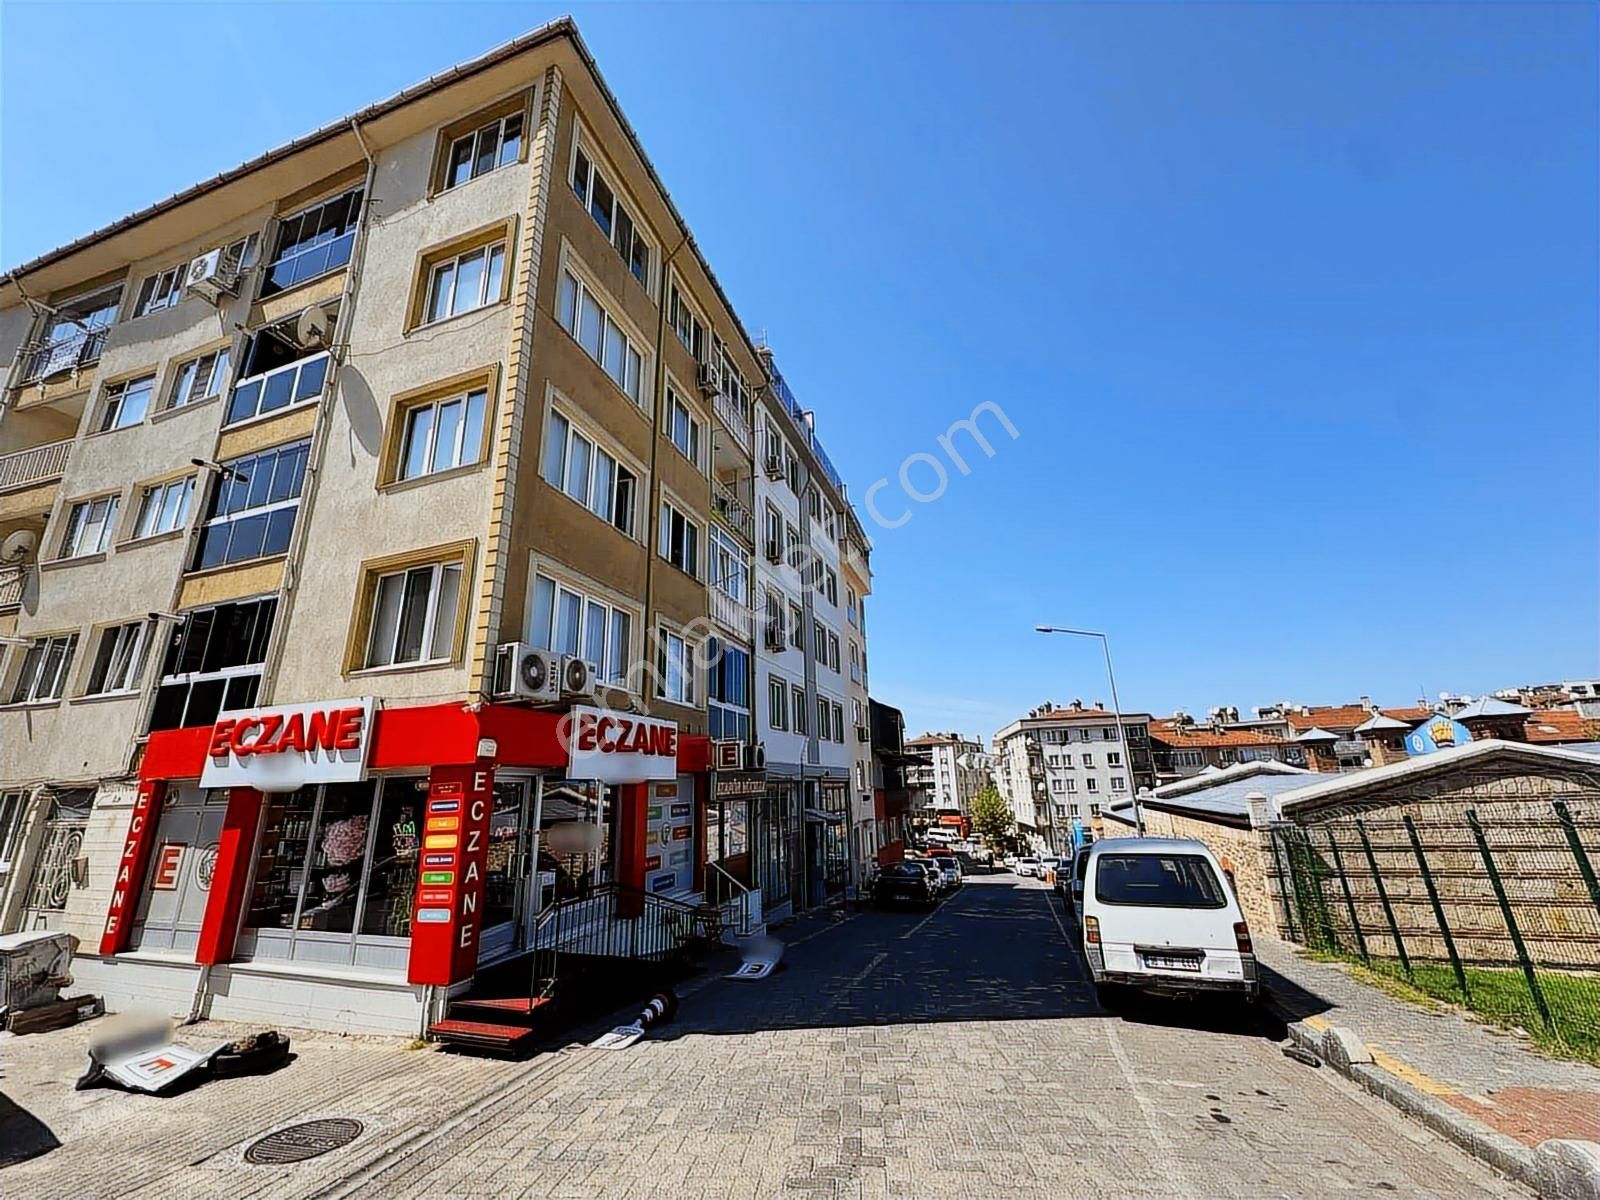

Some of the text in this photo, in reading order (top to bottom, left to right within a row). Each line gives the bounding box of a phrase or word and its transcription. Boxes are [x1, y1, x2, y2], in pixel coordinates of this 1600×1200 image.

[209, 705, 365, 758] ECZANE
[579, 713, 677, 757] ECZANE
[106, 793, 149, 934] ECZANE
[157, 849, 181, 884] E
[460, 771, 487, 948] ECZANE
